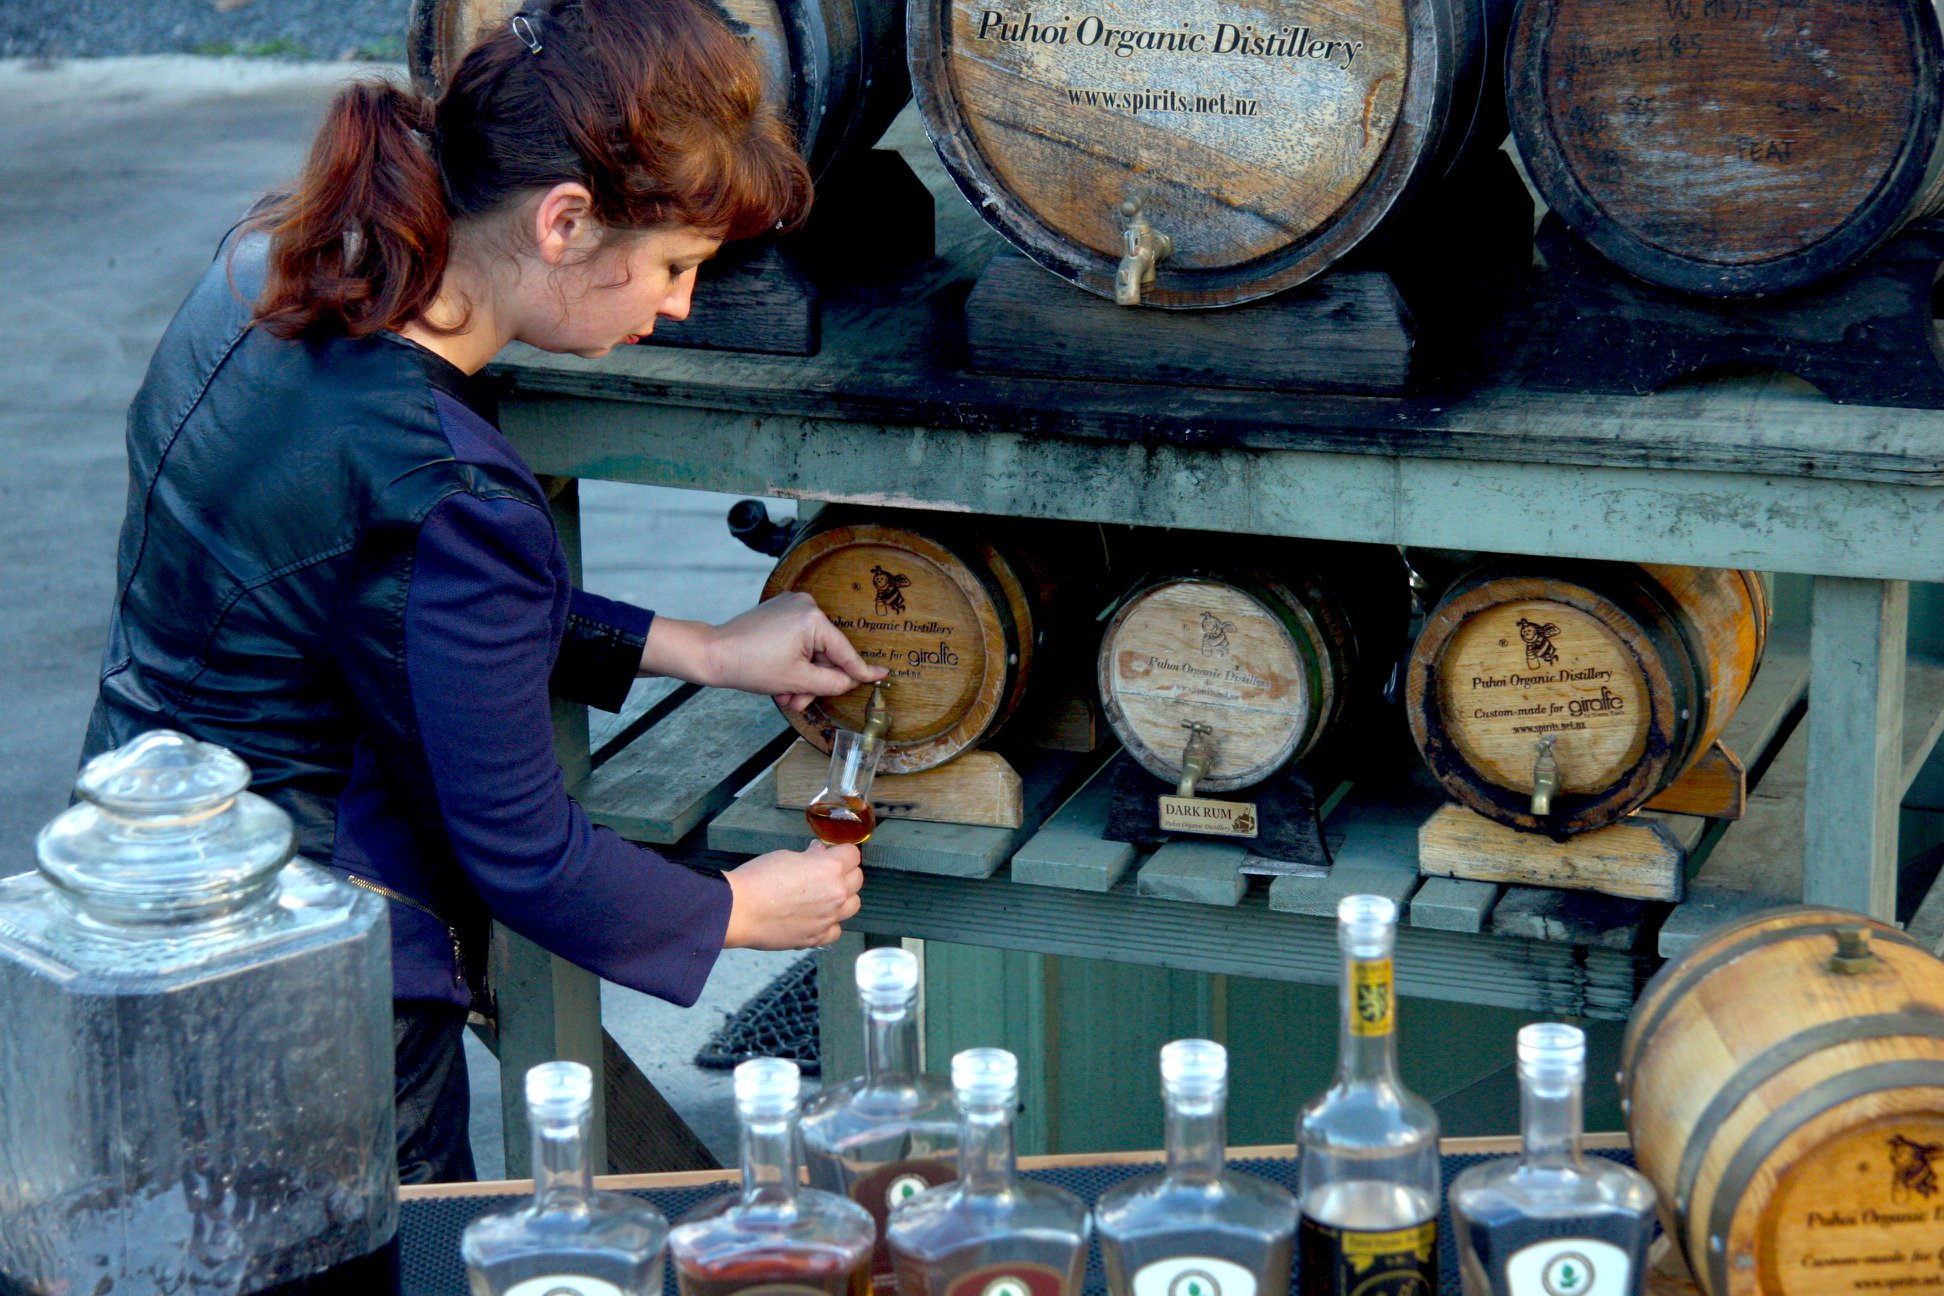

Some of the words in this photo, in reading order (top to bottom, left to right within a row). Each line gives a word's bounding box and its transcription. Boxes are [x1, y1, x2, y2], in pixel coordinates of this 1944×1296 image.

[977, 10, 1069, 45] Puhoi
[1077, 16, 1205, 58] Organic
[1212, 23, 1362, 70] Distillery
[1068, 88, 1258, 116] www.spirits.net.nz
[857, 617, 899, 634] Organic
[903, 620, 954, 639] Distillery
[889, 649, 903, 661] for
[907, 641, 959, 667] giraffe
[1148, 656, 1180, 672] Puhoi
[1472, 675, 1507, 690] Puhoi
[1510, 671, 1556, 688] Organic
[1559, 667, 1613, 683] Distillery
[1474, 704, 1547, 720] Custom-made
[1549, 703, 1565, 717] for
[1568, 686, 1624, 718] giraffe
[1512, 721, 1587, 735] www.spirits.net.nz
[1165, 803, 1201, 817] DARK
[1204, 807, 1232, 820] RUM
